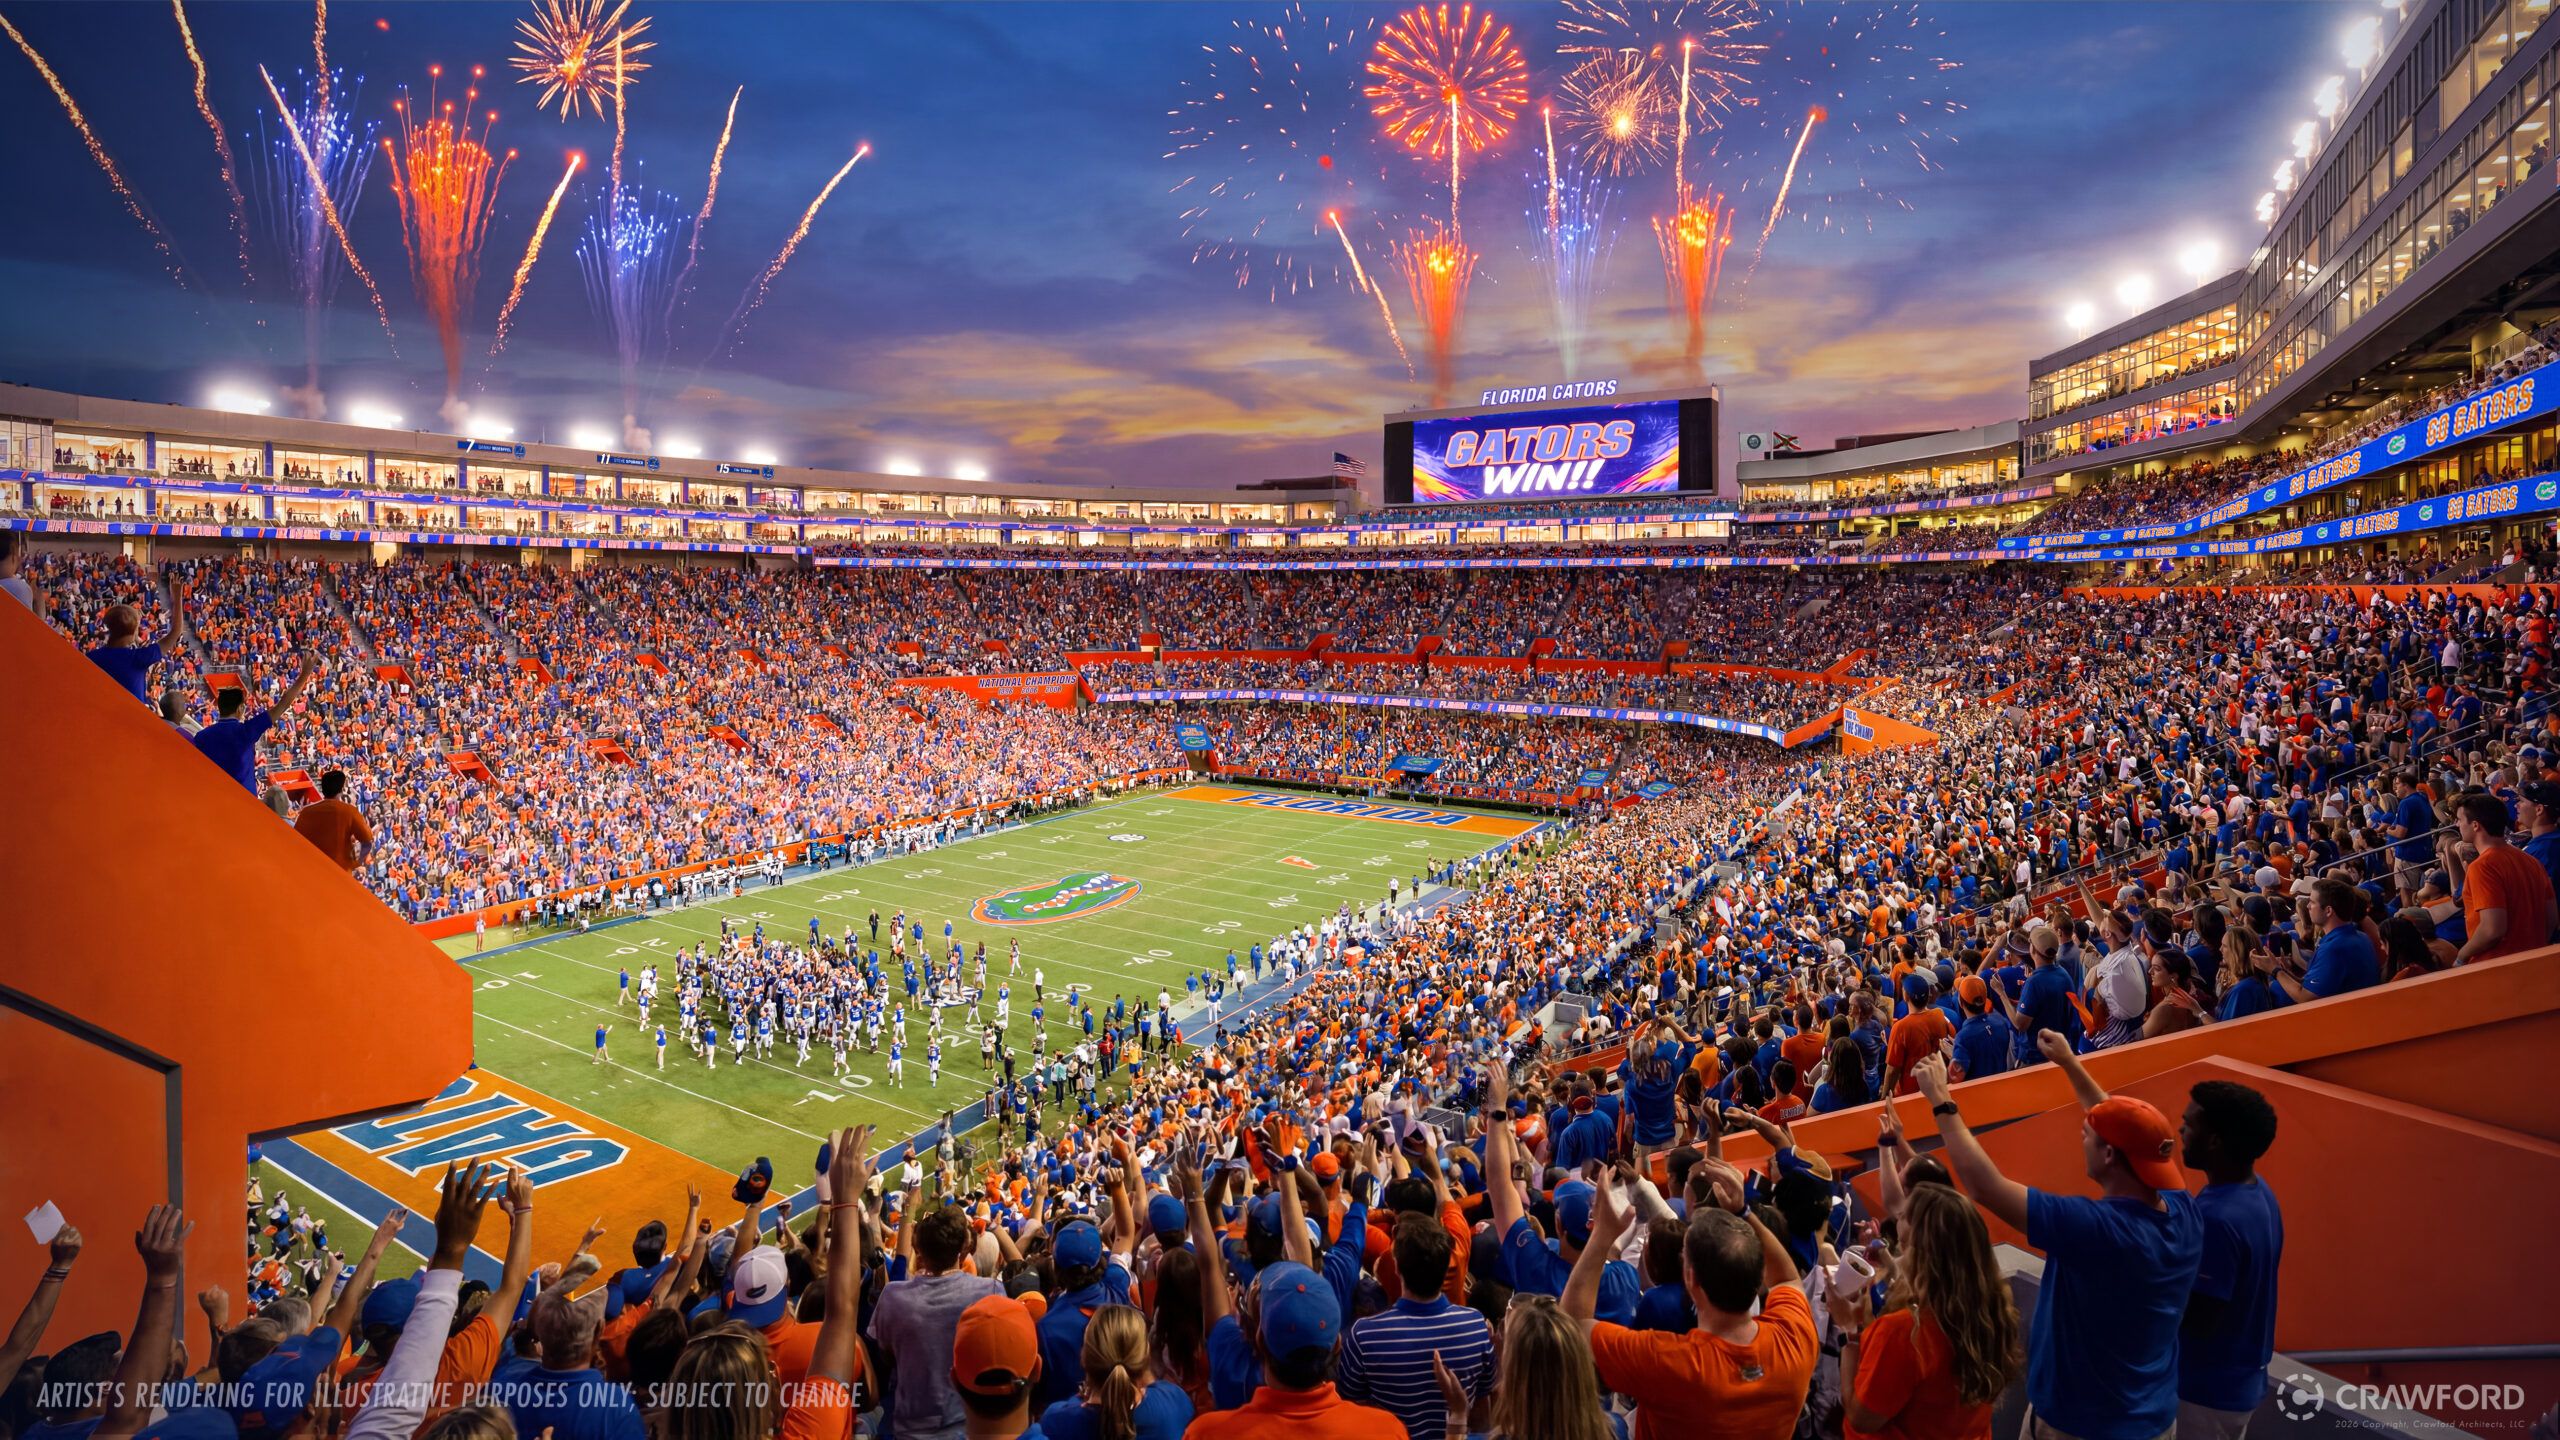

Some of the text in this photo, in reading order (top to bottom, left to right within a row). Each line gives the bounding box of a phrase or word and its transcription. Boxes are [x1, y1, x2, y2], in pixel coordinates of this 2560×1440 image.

[1482, 379, 1618, 406] FLORIDA GATORS
[2426, 378, 2535, 447] GO GATORS
[466, 438, 476, 453] 7
[1444, 419, 1636, 468] GATORS
[600, 453, 611, 464] 11
[719, 463, 731, 474] 15
[1482, 459, 1606, 495] WIN!!
[2289, 451, 2361, 497] GO GATORS
[2200, 497, 2249, 528] GO GATORS
[2447, 485, 2518, 521] GO GATORS
[2339, 510, 2399, 538] GO GATORS
[2266, 531, 2303, 549] GATORS
[978, 675, 1077, 688] NATIONAL CHAMPIONS
[1844, 720, 1874, 742] THE SWAMP
[1222, 793, 1473, 826] FLORIDA
[1202, 920, 1242, 935] 50
[1131, 949, 1173, 965] 40
[807, 1074, 873, 1103] 10
